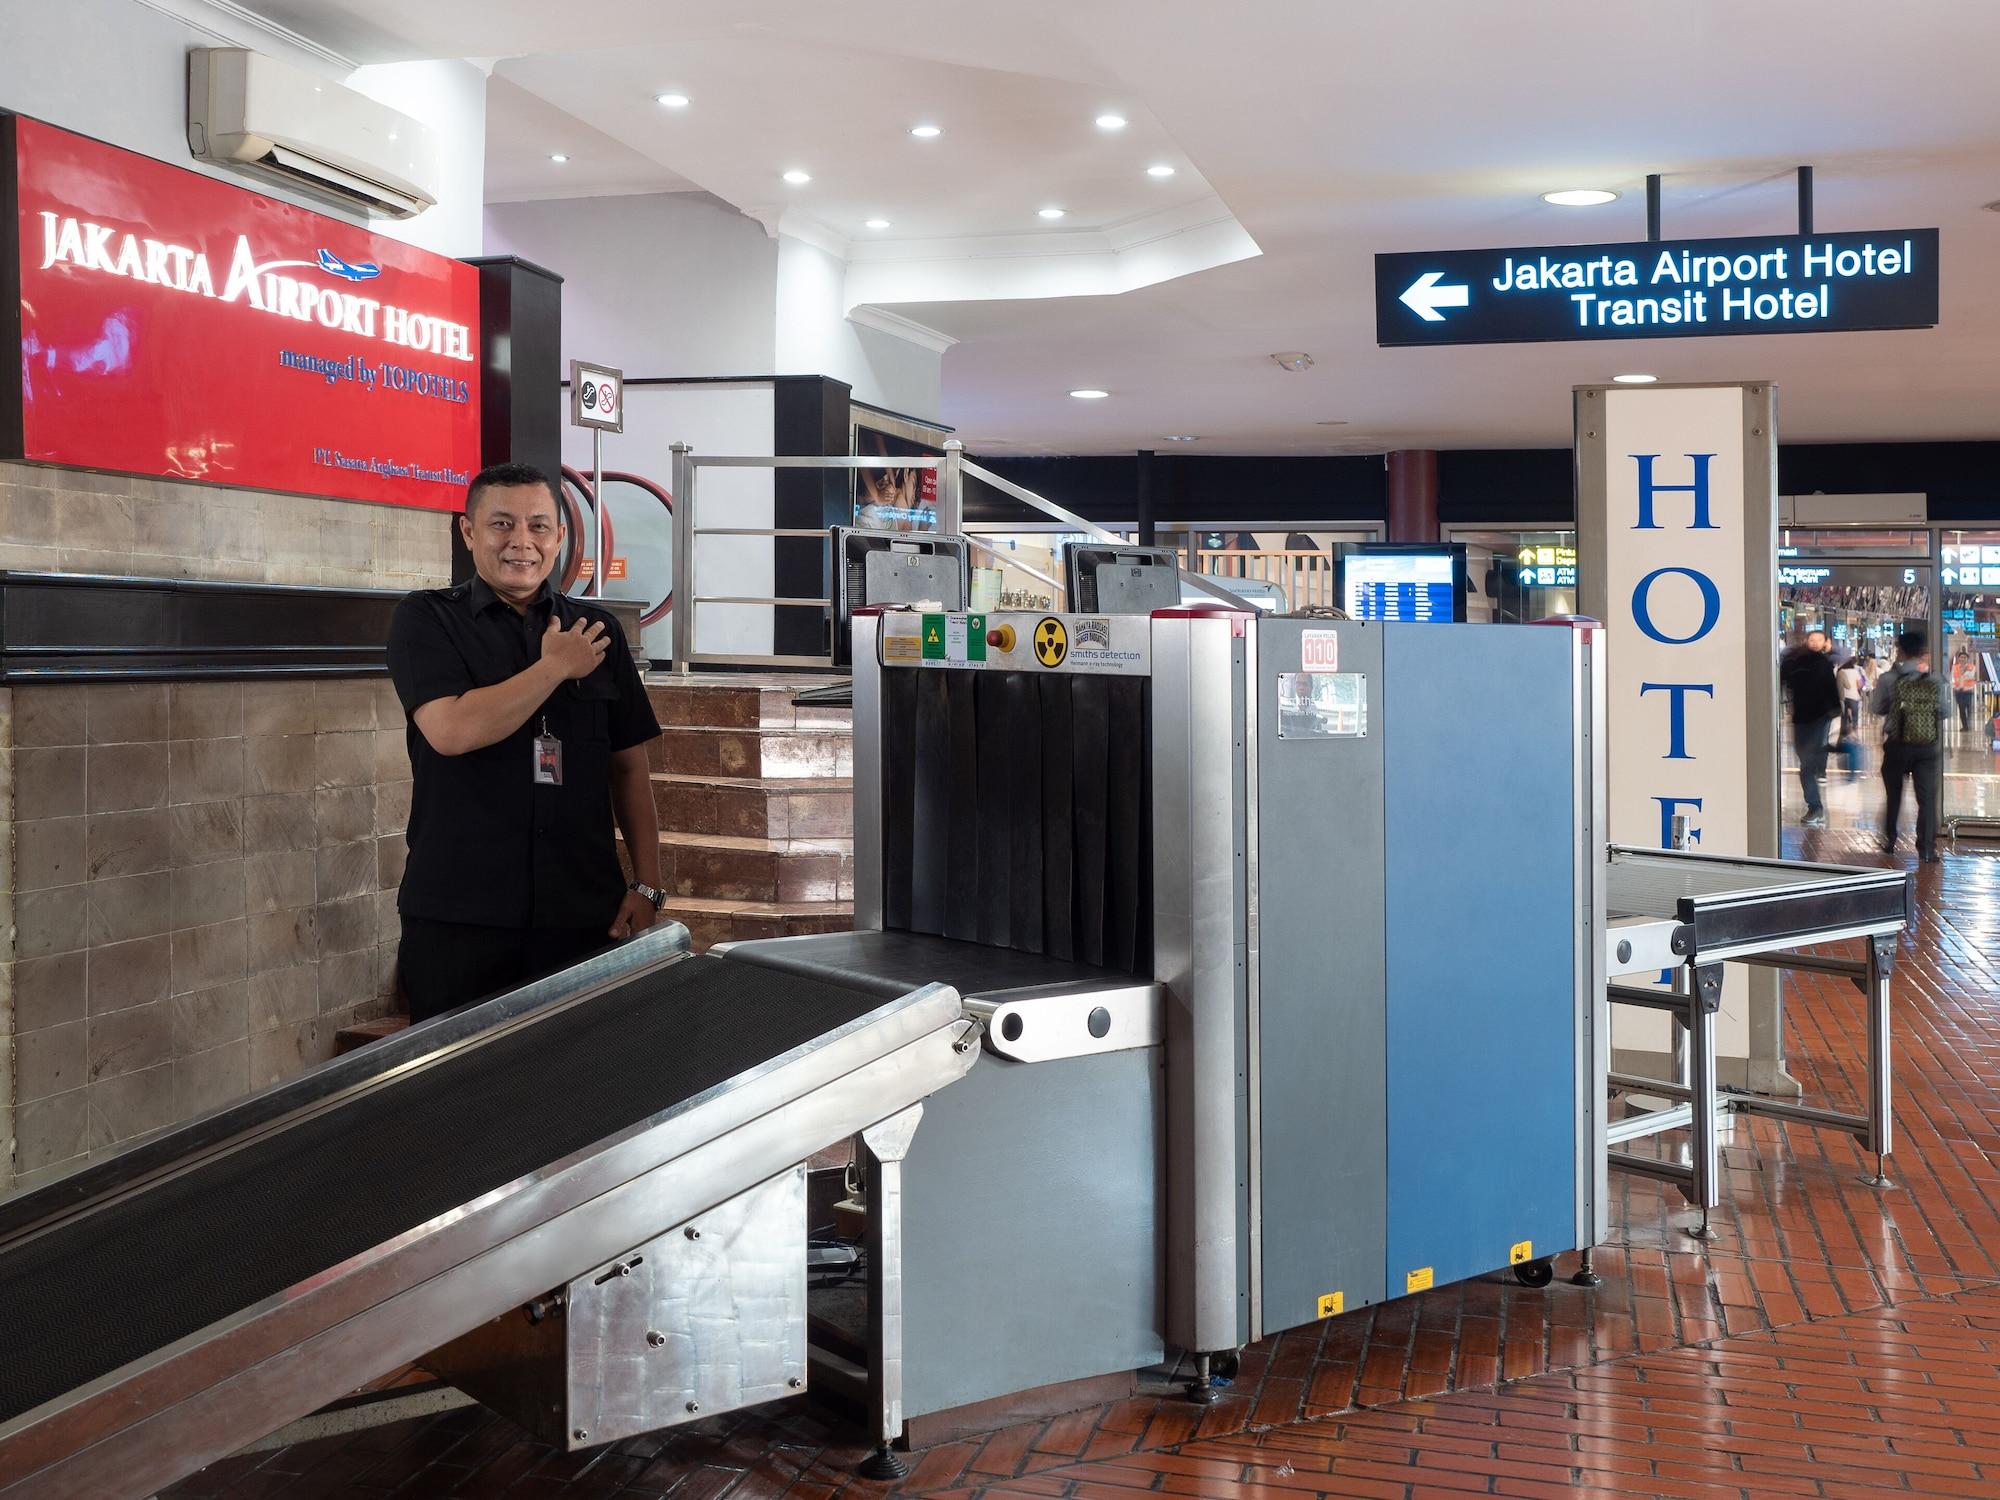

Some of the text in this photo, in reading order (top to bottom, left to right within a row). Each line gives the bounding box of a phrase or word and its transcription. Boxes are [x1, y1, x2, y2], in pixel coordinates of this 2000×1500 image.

[1493, 240, 1912, 293] Jakarta Airport Hotel
[40, 211, 475, 362] JAKARTA AIRPORT HOTEL
[1571, 285, 1829, 327] Transit Hotel
[279, 350, 470, 404] managed by TOPOTELS
[1557, 568, 1575, 576] ATM
[1557, 576, 1575, 584] ATM
[1796, 575, 1819, 584] Point
[1903, 569, 1916, 584] 5
[1070, 650, 1141, 660] smiths detection
[1305, 639, 1335, 664] 110
[1628, 453, 1721, 984] HOTE
